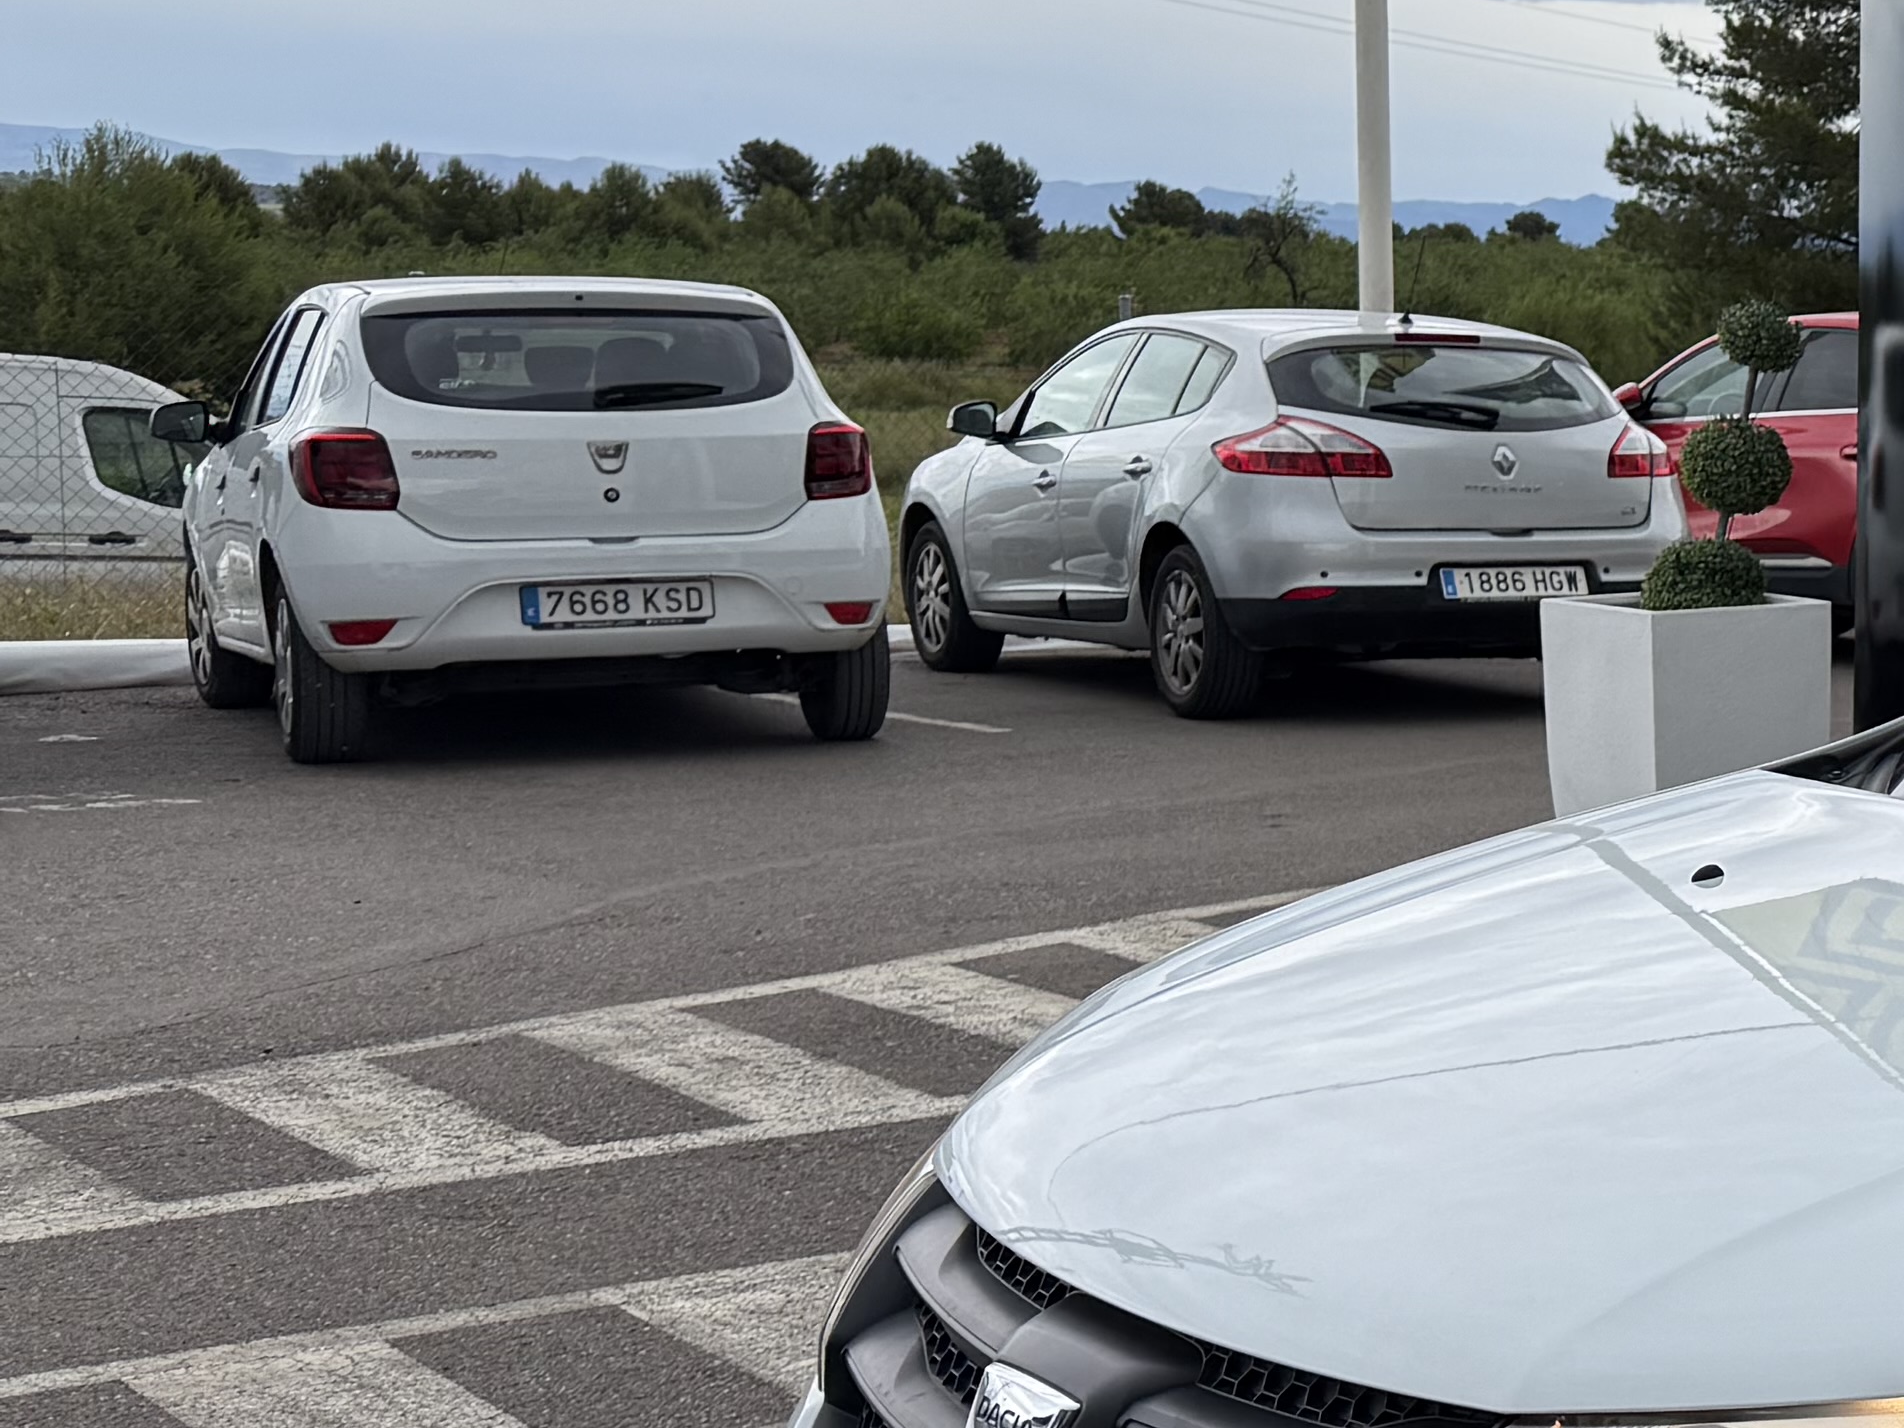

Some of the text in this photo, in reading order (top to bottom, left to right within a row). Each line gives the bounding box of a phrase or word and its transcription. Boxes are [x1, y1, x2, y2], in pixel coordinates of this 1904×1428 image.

[1464, 569, 1579, 595] 1886 HGW
[546, 586, 704, 617] 7668 KSD
